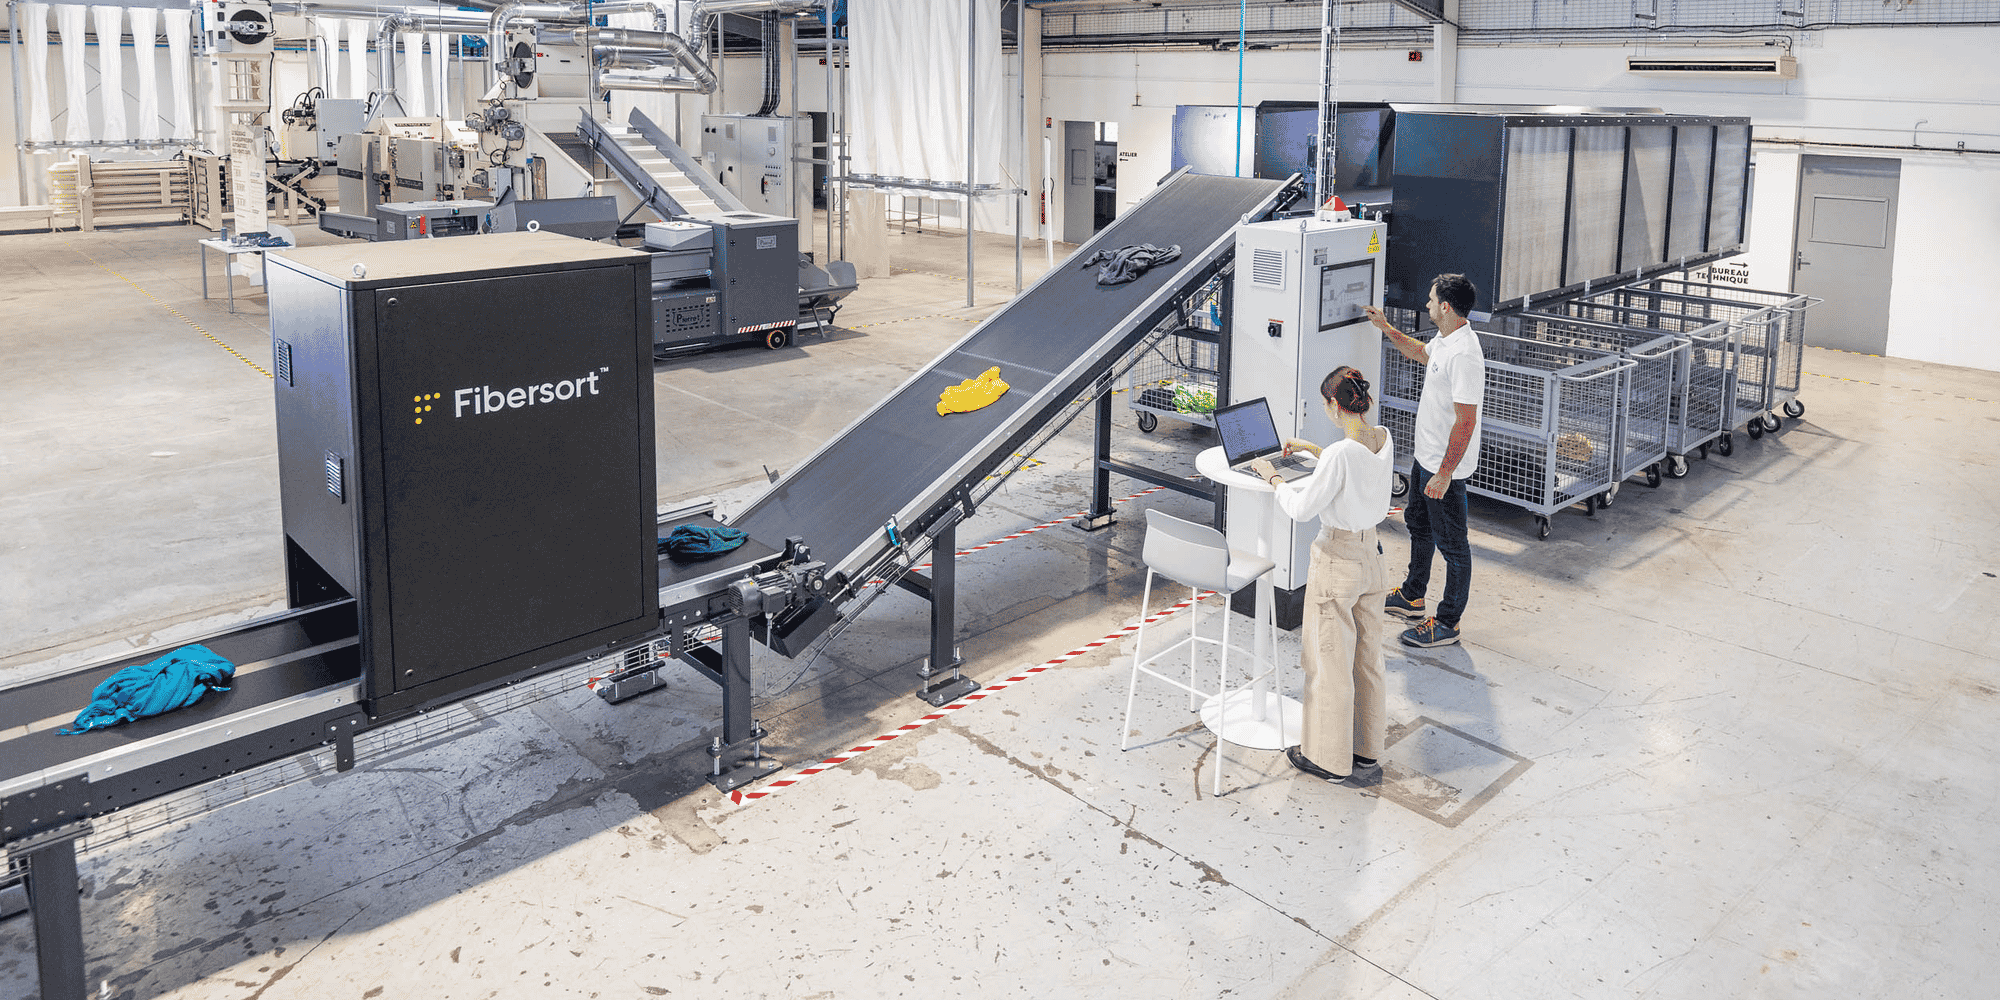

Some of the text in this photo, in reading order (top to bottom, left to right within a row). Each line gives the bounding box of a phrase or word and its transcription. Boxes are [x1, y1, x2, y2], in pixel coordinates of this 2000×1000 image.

[1696, 272, 1749, 284] TEHNIQUE
[1711, 267, 1749, 277] BUREAU
[454, 371, 600, 418] Fibersort
